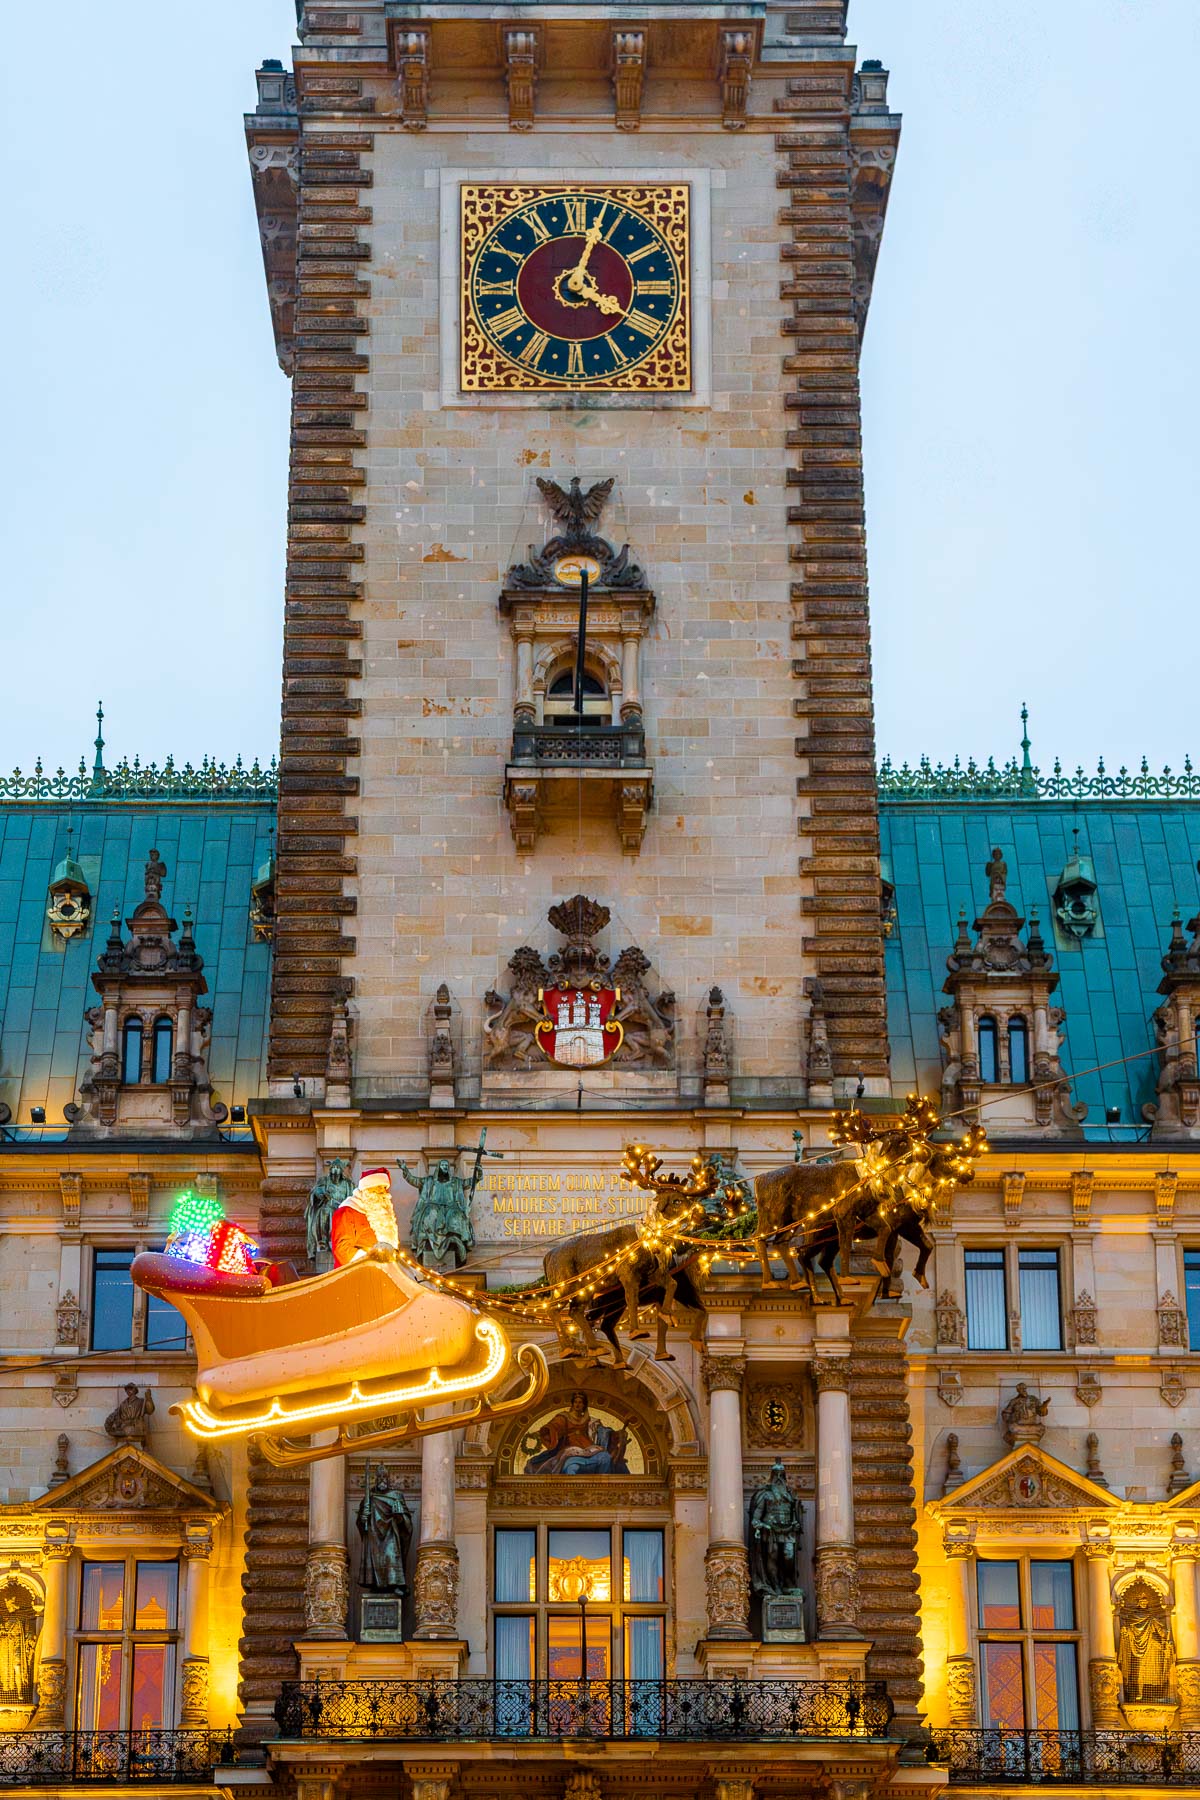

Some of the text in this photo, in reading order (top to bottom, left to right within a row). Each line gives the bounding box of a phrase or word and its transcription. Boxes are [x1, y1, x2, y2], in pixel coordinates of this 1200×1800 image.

[520, 208, 552, 243] XI
[562, 201, 587, 233] XII
[604, 210, 626, 242] I
[489, 240, 525, 266] X
[626, 240, 662, 264] II
[475, 278, 514, 297] IX
[637, 280, 672, 296] III
[486, 306, 527, 341] VIII
[624, 308, 665, 341] IIII
[517, 331, 550, 369] VII
[567, 343, 587, 374] VI
[605, 334, 629, 365] V
[566, 1174, 604, 1192] QUAM
[493, 1196, 557, 1214] MAIORES
[561, 1196, 603, 1214] DIGNE
[504, 1218, 566, 1236] SERVARE
